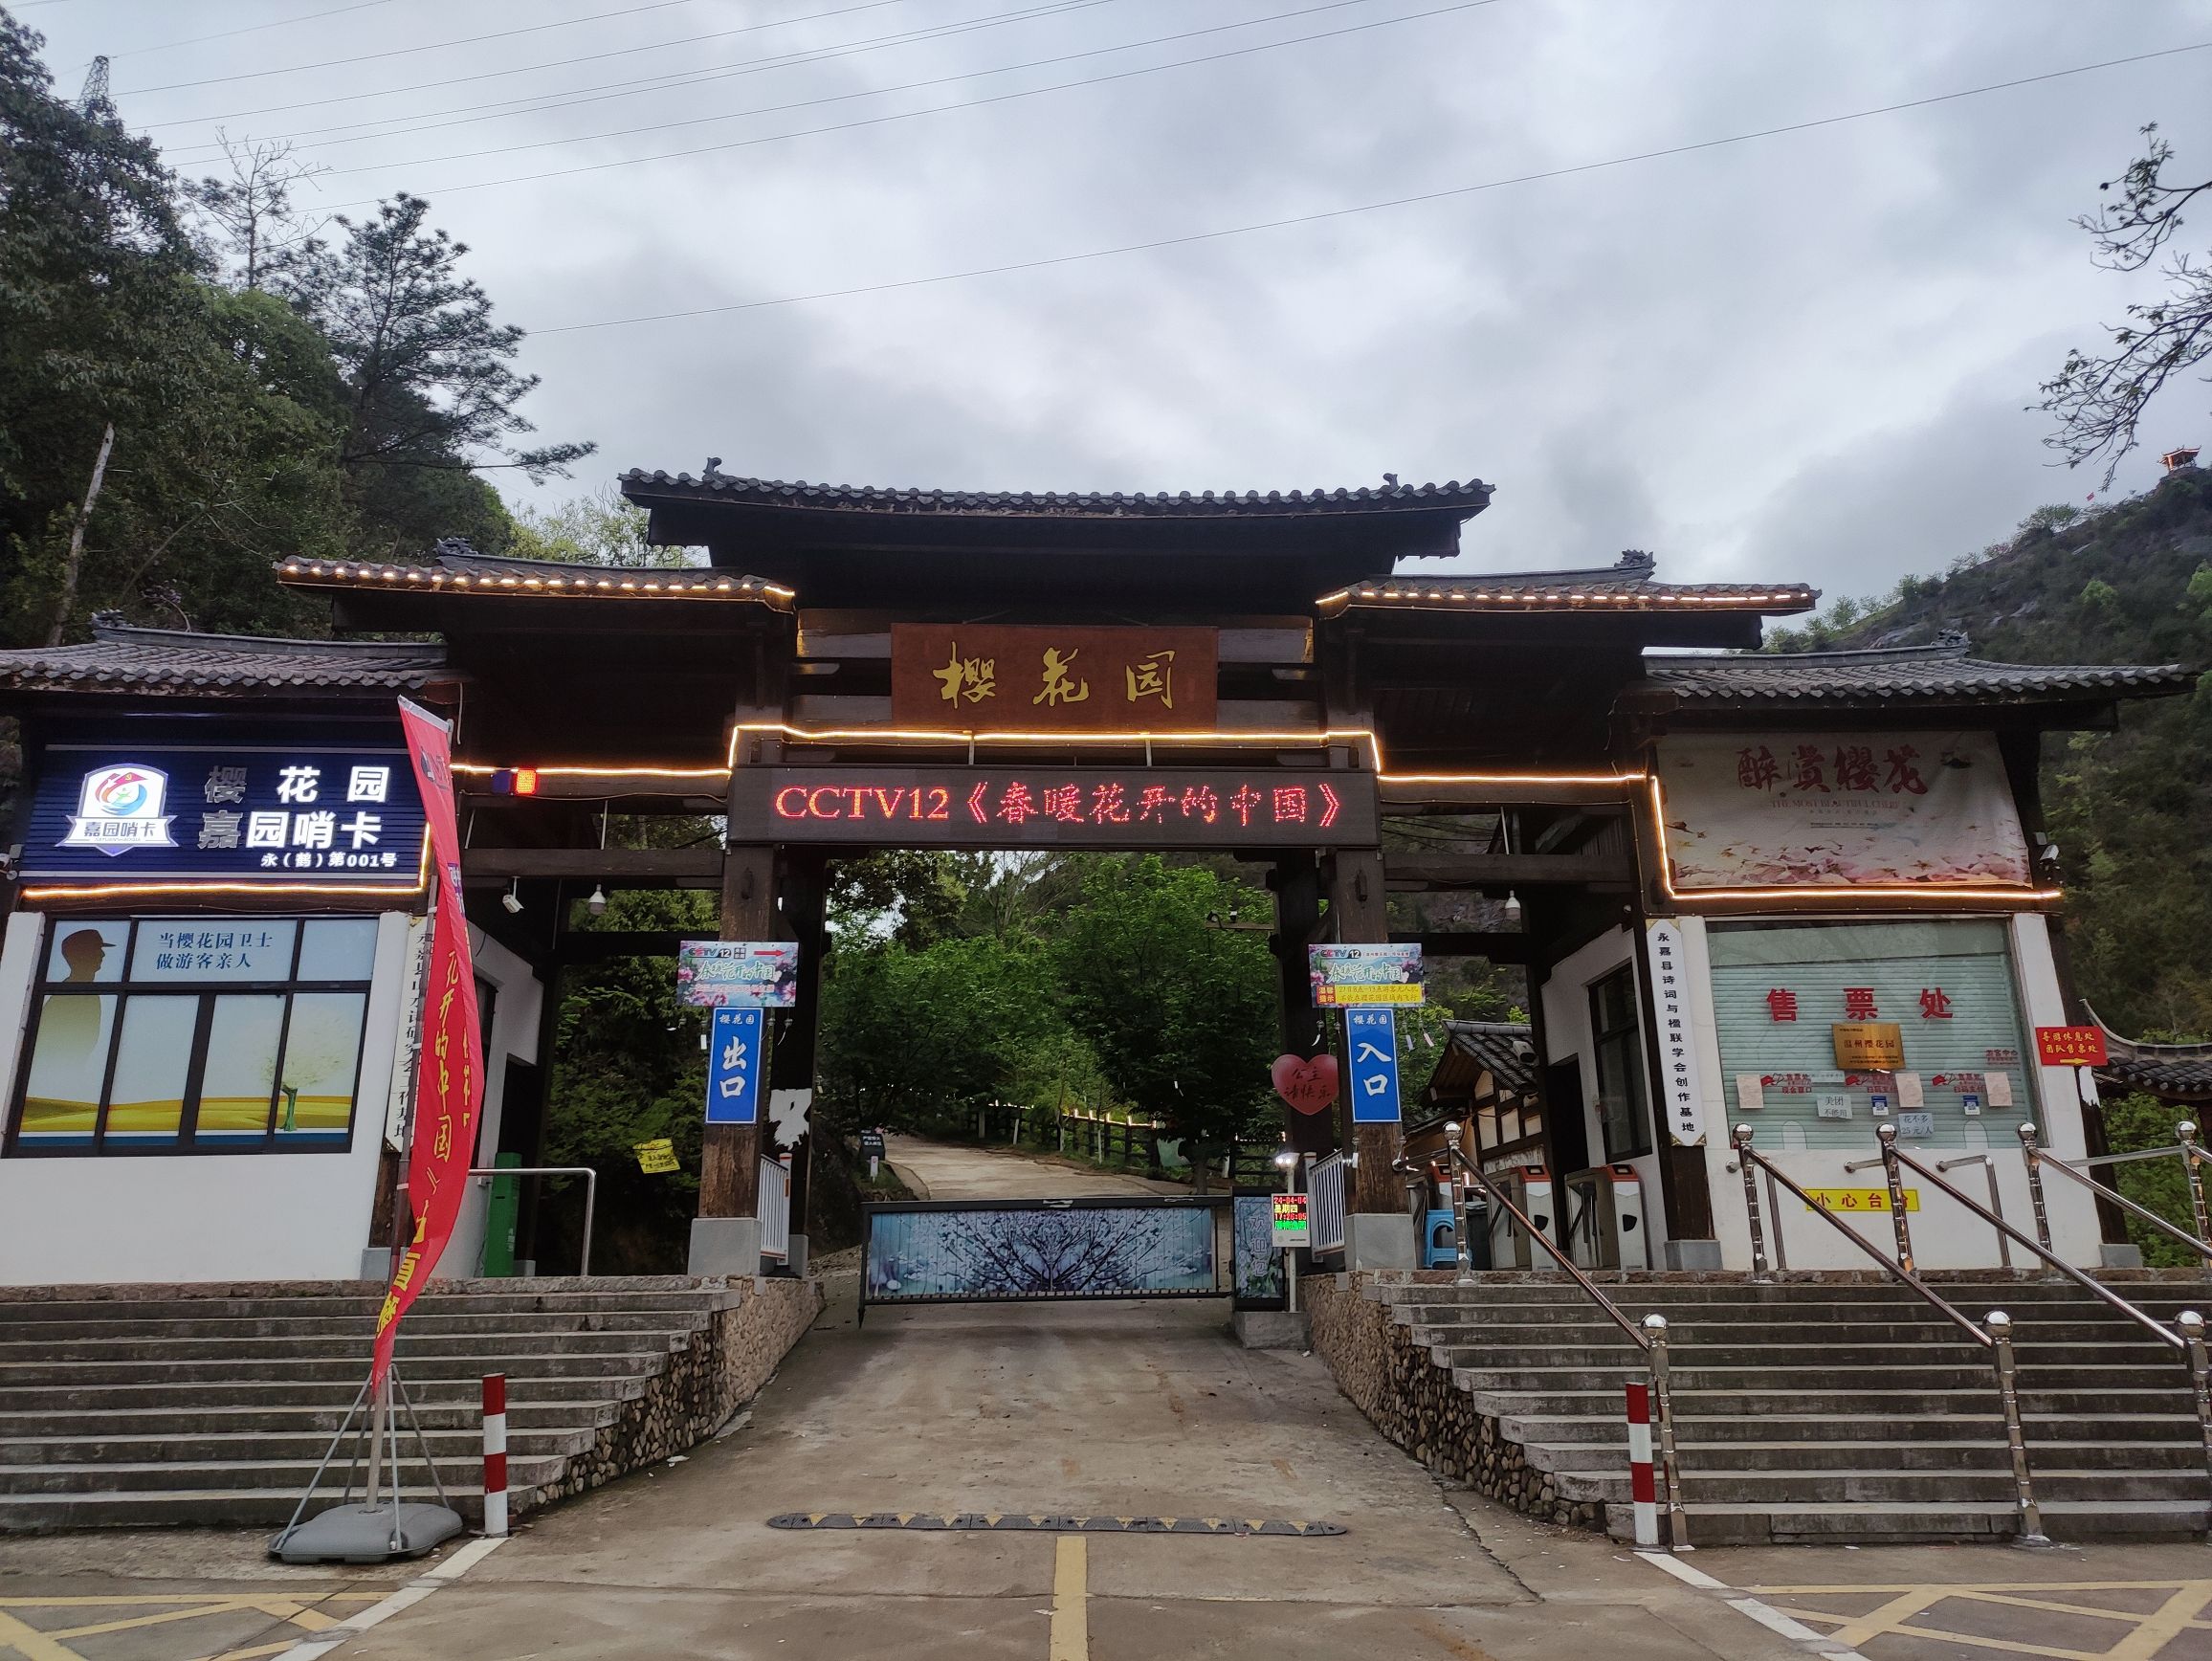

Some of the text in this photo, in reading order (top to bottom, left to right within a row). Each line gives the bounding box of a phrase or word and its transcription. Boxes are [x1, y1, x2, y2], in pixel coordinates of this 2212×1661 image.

[204, 765, 390, 804] 樱花园
[774, 780, 1341, 828] CCTV12 《春暖花开的中国》
[83, 821, 157, 837] 嘉园哨卡
[196, 810, 382, 850] 嘉园哨卡
[157, 931, 274, 950] 当樱花园卫士
[156, 952, 253, 970] 做游客亲人
[1766, 986, 1954, 1022] 售票处
[719, 1013, 755, 1025] 樱花园
[1353, 1014, 1387, 1025] 樱花园
[1657, 932, 1695, 1133] 永嘉县诗词与楹联学会创作基地
[2046, 1043, 2098, 1054] 团队售票处
[719, 1035, 747, 1098] 出口
[1357, 1042, 1392, 1096] 入口
[1274, 1205, 1298, 1213] 星期四
